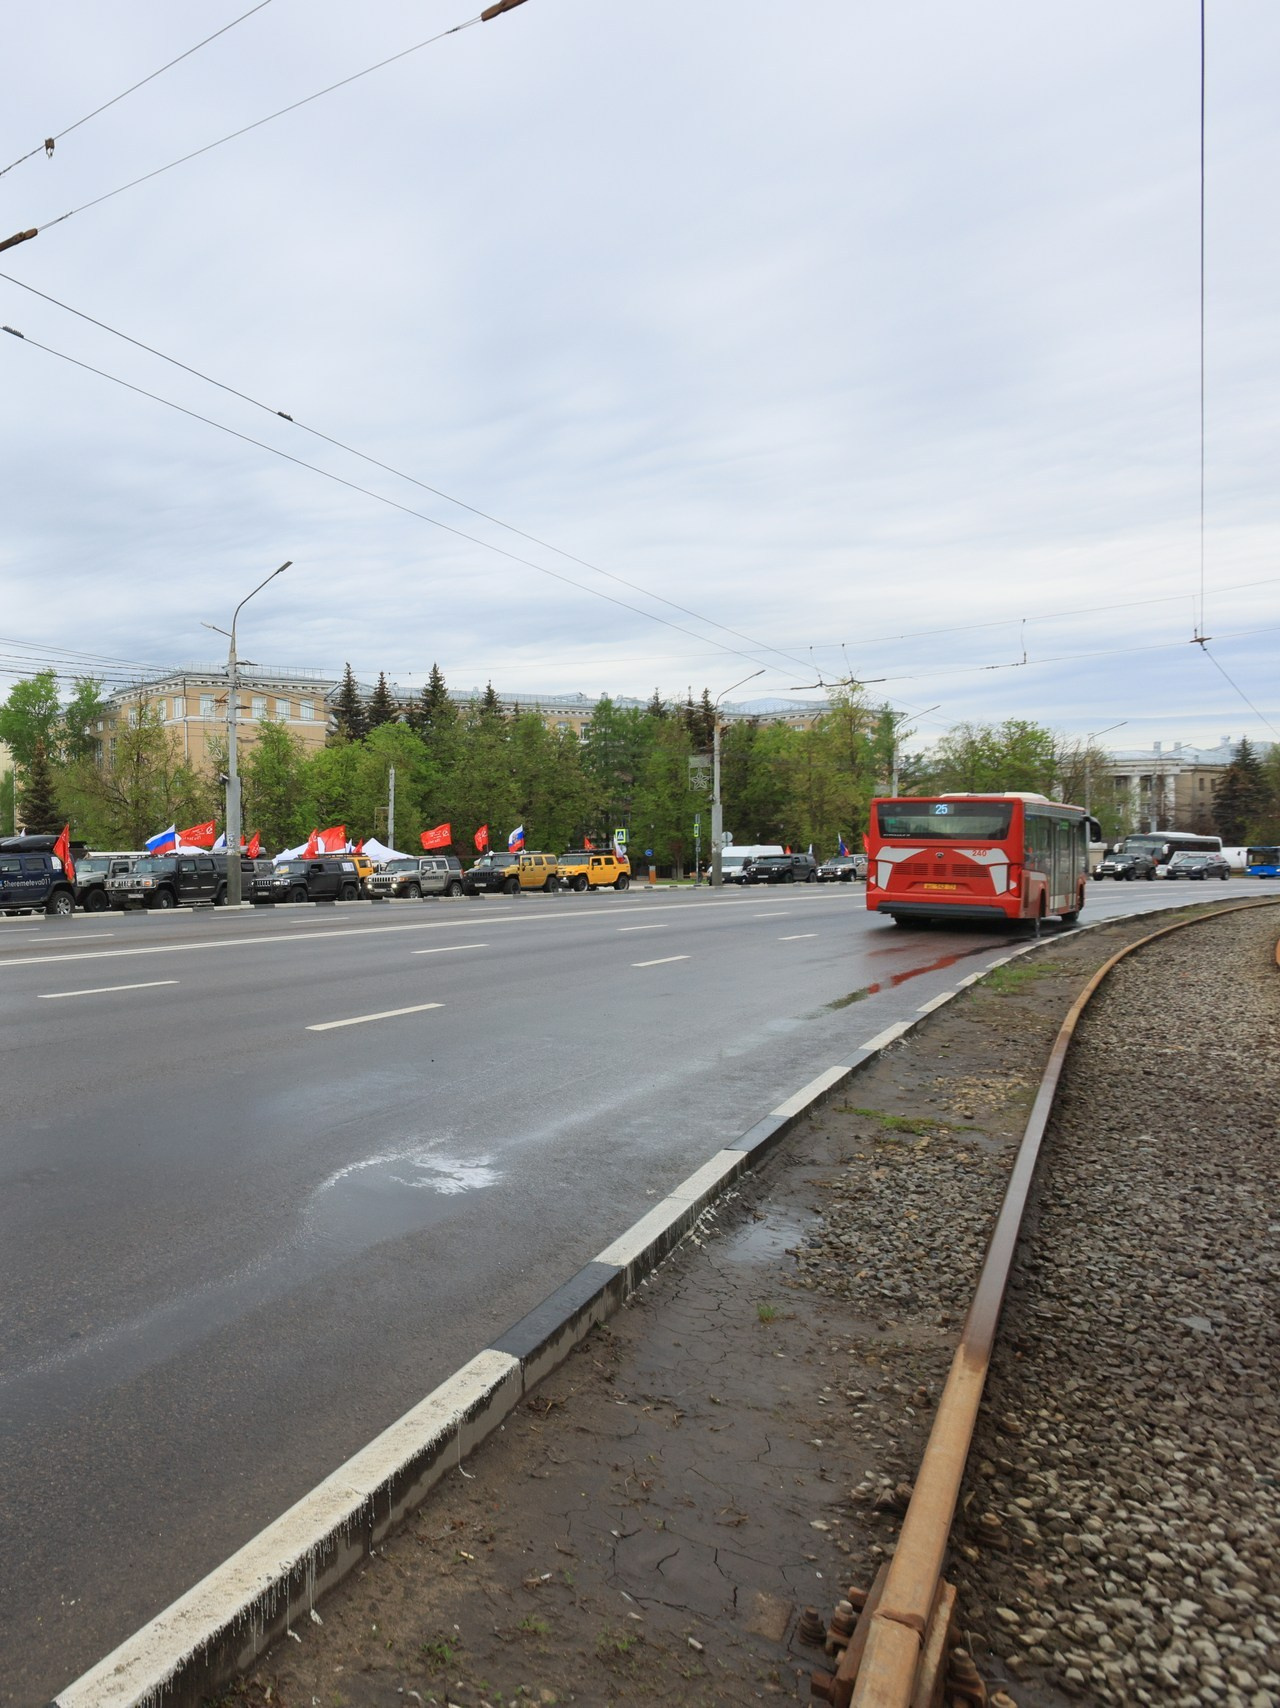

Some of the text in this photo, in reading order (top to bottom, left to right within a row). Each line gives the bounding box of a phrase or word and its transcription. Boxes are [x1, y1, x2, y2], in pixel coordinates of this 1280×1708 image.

[935, 804, 948, 815] 25
[972, 849, 987, 857] 240
[3, 878, 51, 888] Sheremeteva011
